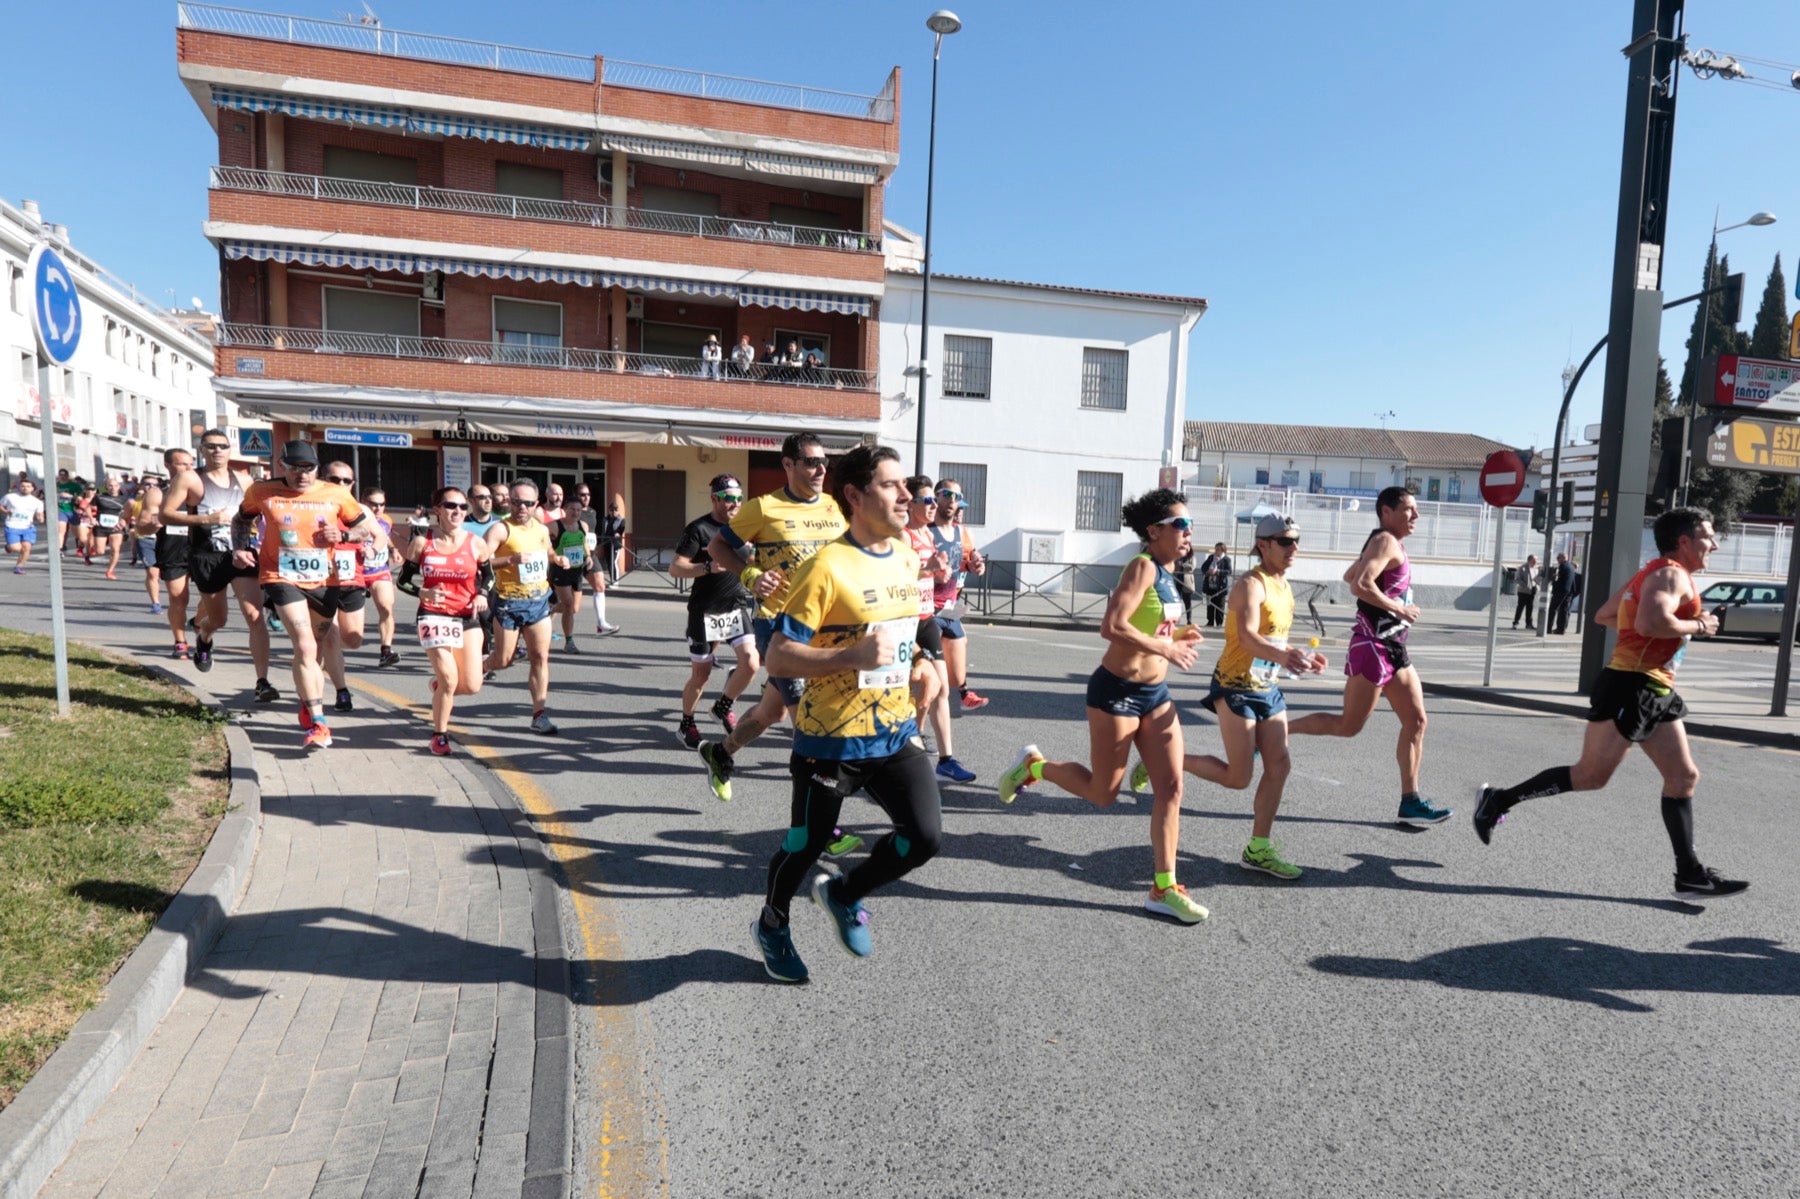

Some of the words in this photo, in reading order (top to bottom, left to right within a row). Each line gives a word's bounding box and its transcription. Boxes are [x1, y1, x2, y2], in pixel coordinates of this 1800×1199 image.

[1735, 387, 1770, 399] SANTOS
[310, 408, 420, 425] RESTAURANTE
[536, 422, 595, 437] PARADA
[327, 432, 362, 442] Granada
[1773, 425, 1800, 450] EST
[1714, 442, 1727, 451] 100
[288, 558, 320, 571] 190
[525, 560, 544, 574] 981
[710, 616, 739, 629] 3024
[422, 625, 461, 638] 2136
